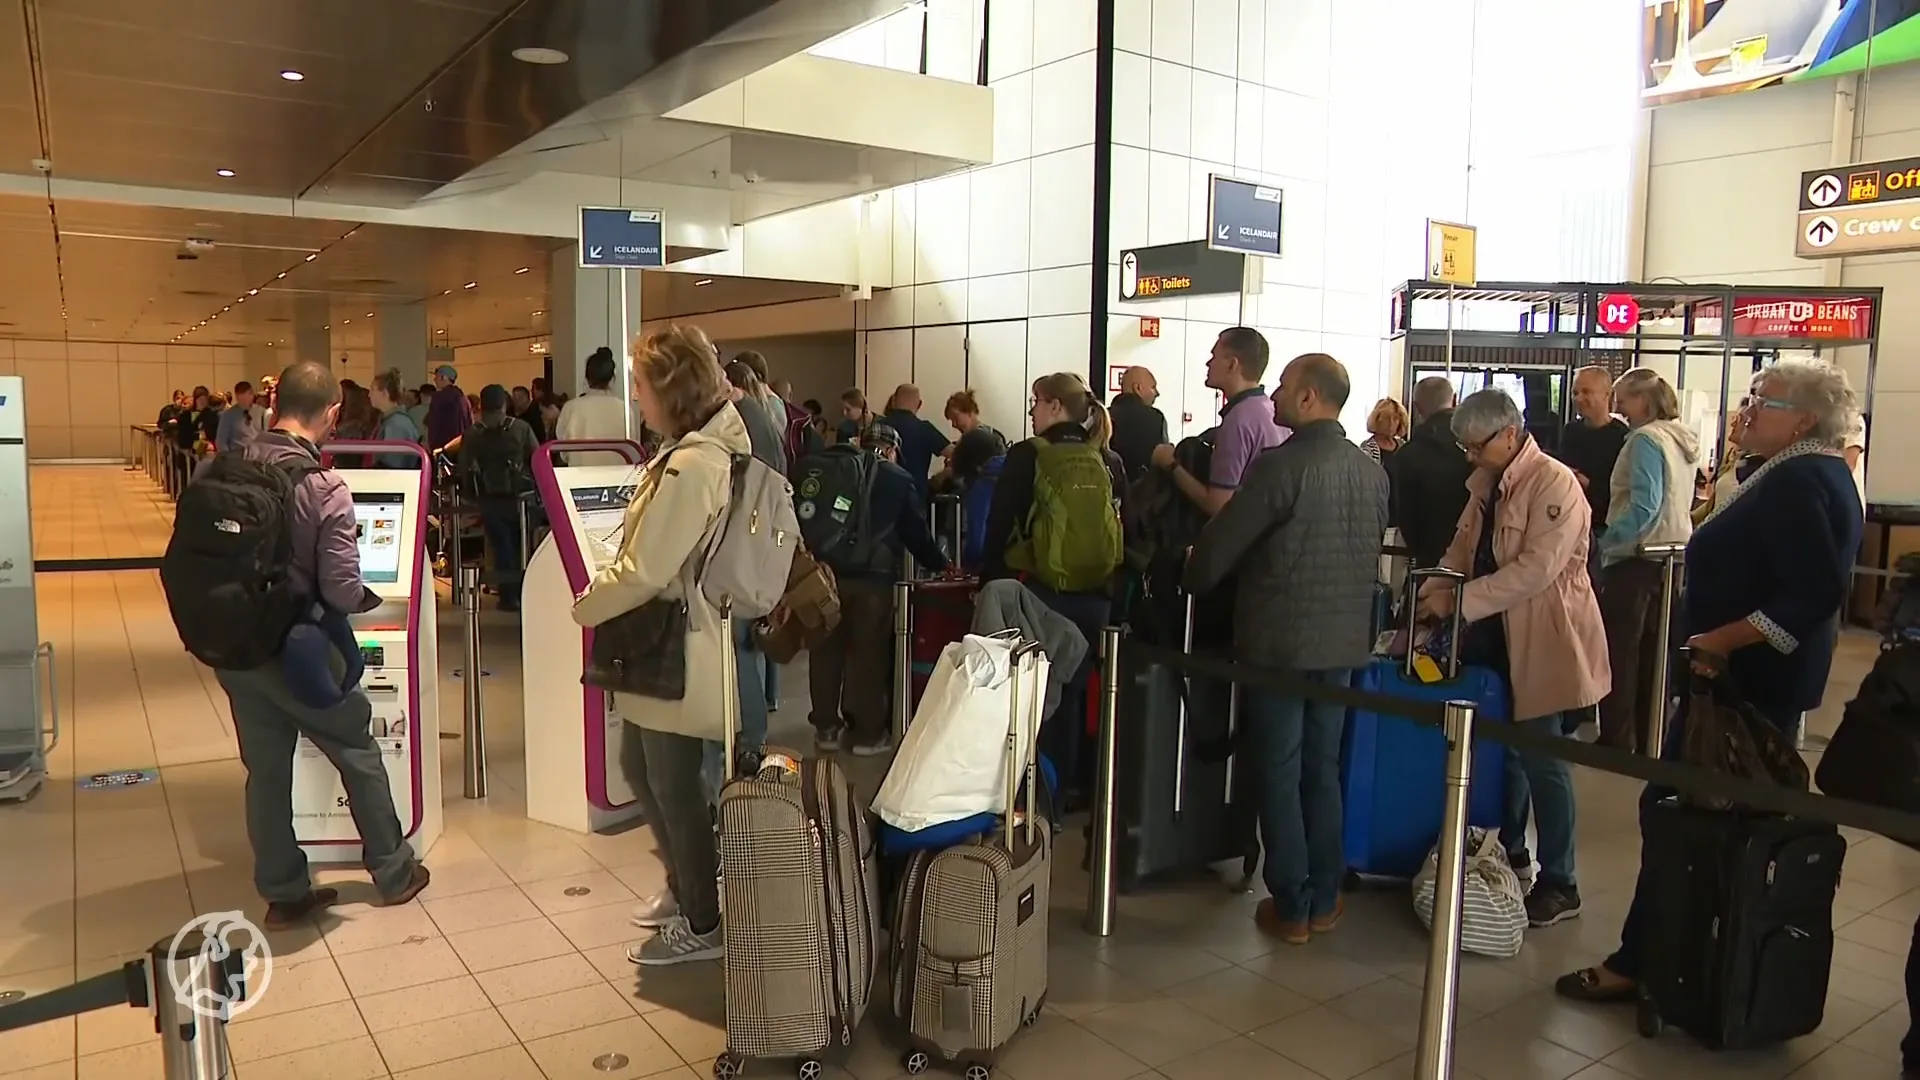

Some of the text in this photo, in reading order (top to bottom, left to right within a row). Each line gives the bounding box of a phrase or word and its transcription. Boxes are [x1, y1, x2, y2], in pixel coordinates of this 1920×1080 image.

[1239, 226, 1278, 240] ICELANDAIR
[1844, 218, 1903, 237] Crew
[614, 246, 659, 255] ICELANDAIR
[1161, 277, 1191, 290] Toilets
[1746, 304, 1785, 319] URBAN
[1817, 304, 1858, 320] BEANS
[1768, 324, 1799, 332] COFFEE
